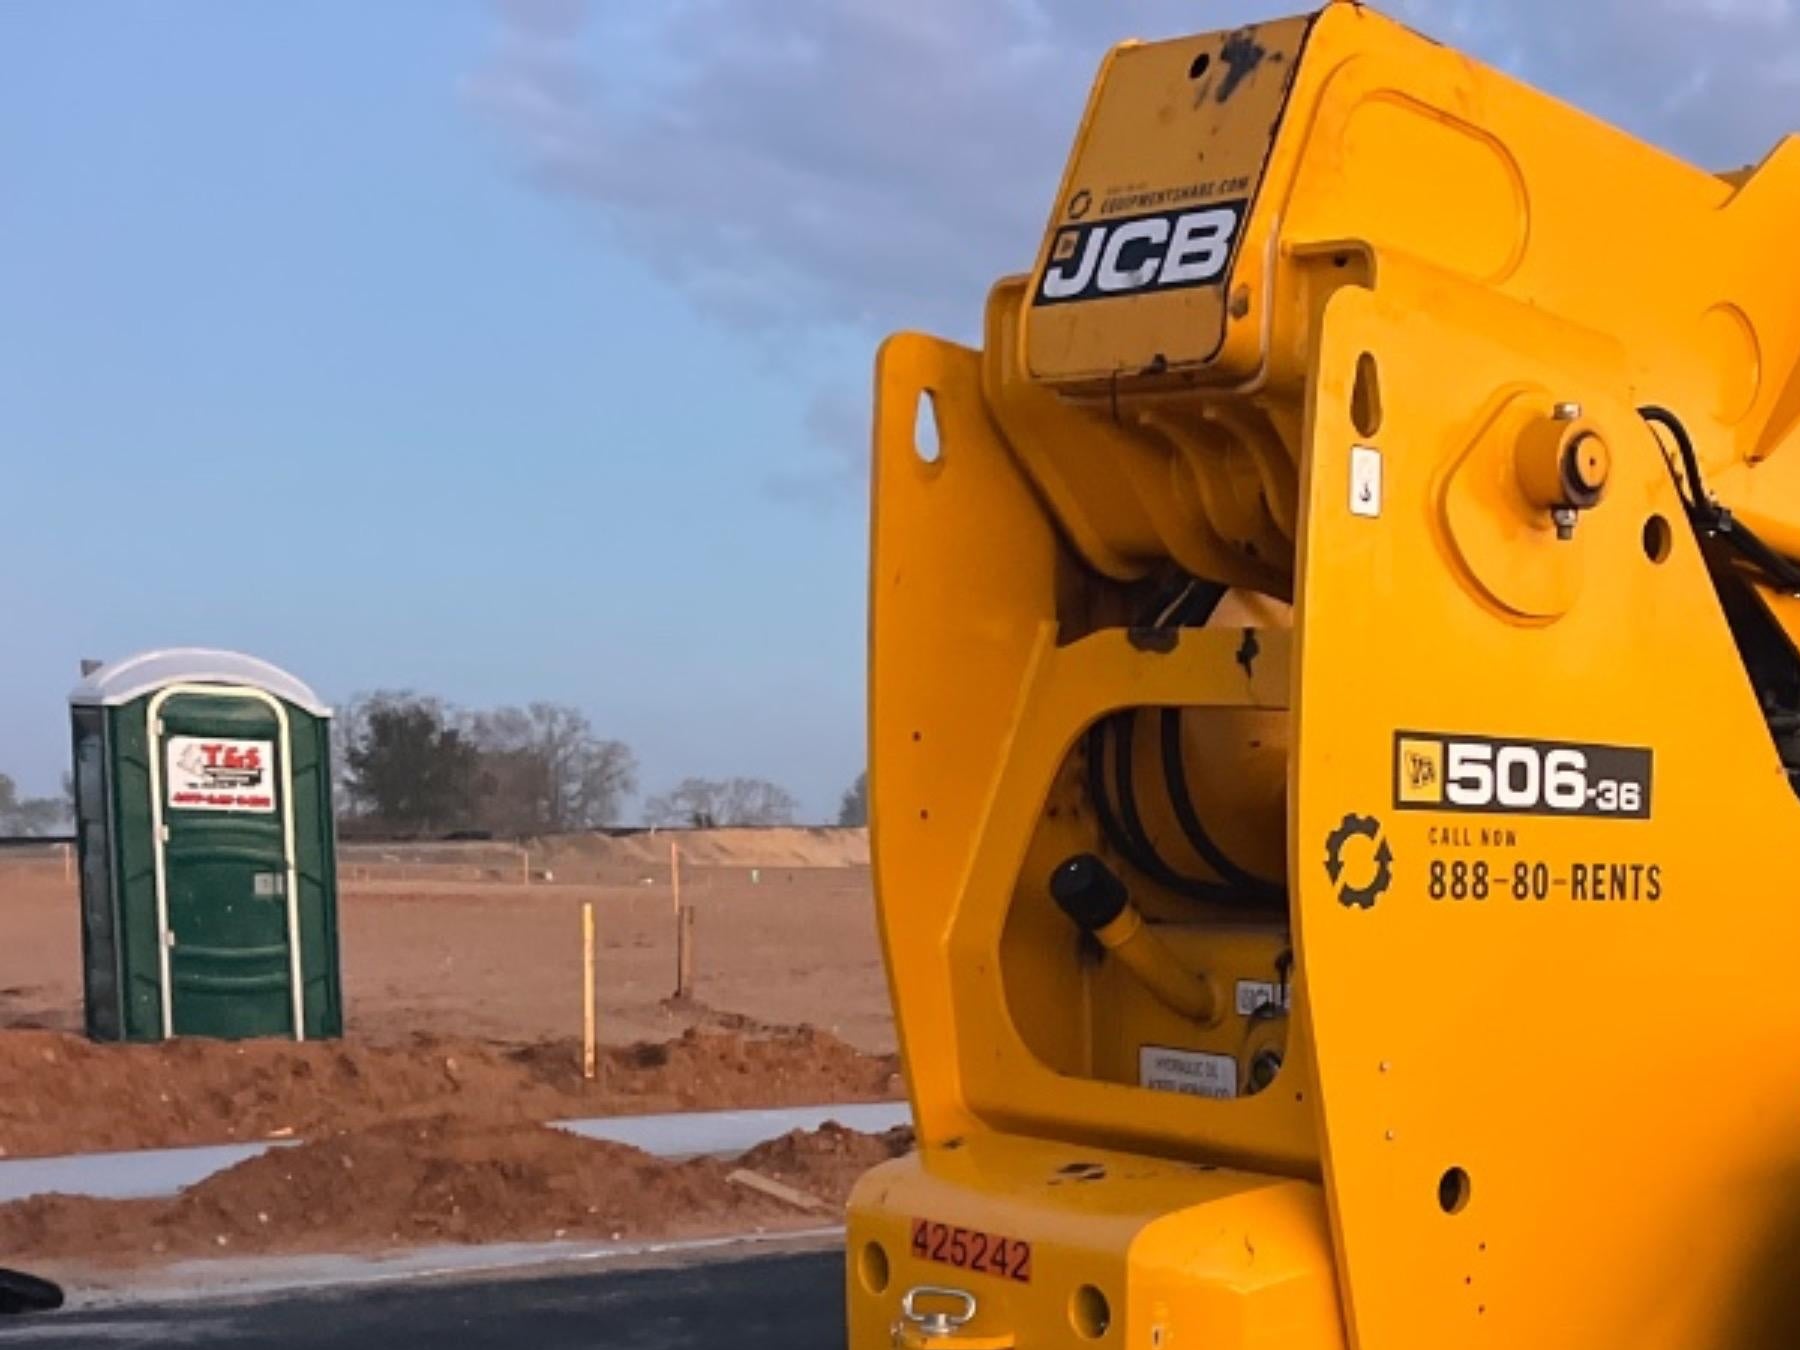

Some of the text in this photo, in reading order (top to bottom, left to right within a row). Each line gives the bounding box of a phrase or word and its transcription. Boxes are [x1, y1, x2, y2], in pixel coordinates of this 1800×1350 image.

[1043, 207, 1237, 299] JCB
[1428, 827, 1517, 847] CALL NOW
[1428, 859, 1663, 901] 888-80-RENTS
[911, 1219, 1032, 1283] 425242
